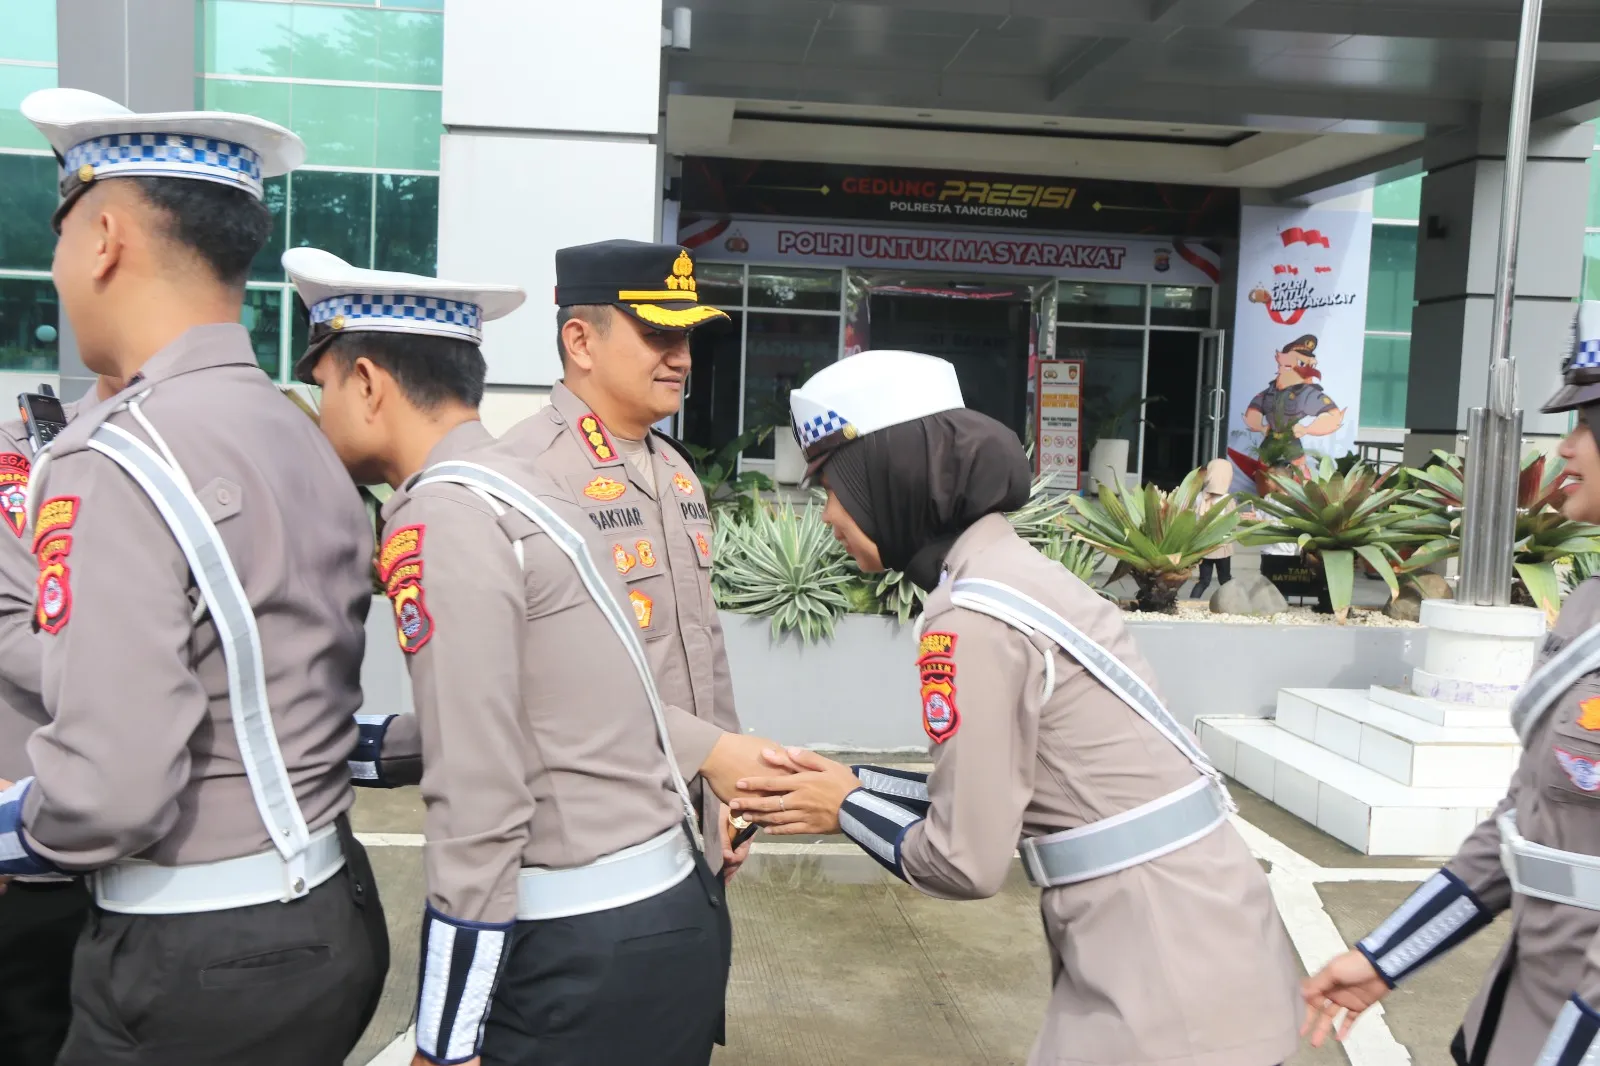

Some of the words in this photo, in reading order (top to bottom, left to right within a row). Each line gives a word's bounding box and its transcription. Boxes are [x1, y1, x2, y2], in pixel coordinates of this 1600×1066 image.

[841, 177, 937, 198] GEDUNG
[938, 180, 1077, 209] PRESISI
[889, 201, 952, 214] POLRESTA
[954, 205, 1028, 218] TANGERANG
[778, 231, 854, 256] POLRI
[859, 235, 951, 262] UNTUK
[952, 239, 1126, 269] MASYARAKAT
[1271, 287, 1314, 301] UNTUK
[1272, 279, 1307, 291] POLRI
[1271, 294, 1356, 312] MASYARAKAT
[589, 507, 643, 530] BAKTIAR
[681, 502, 709, 520] POLRI
